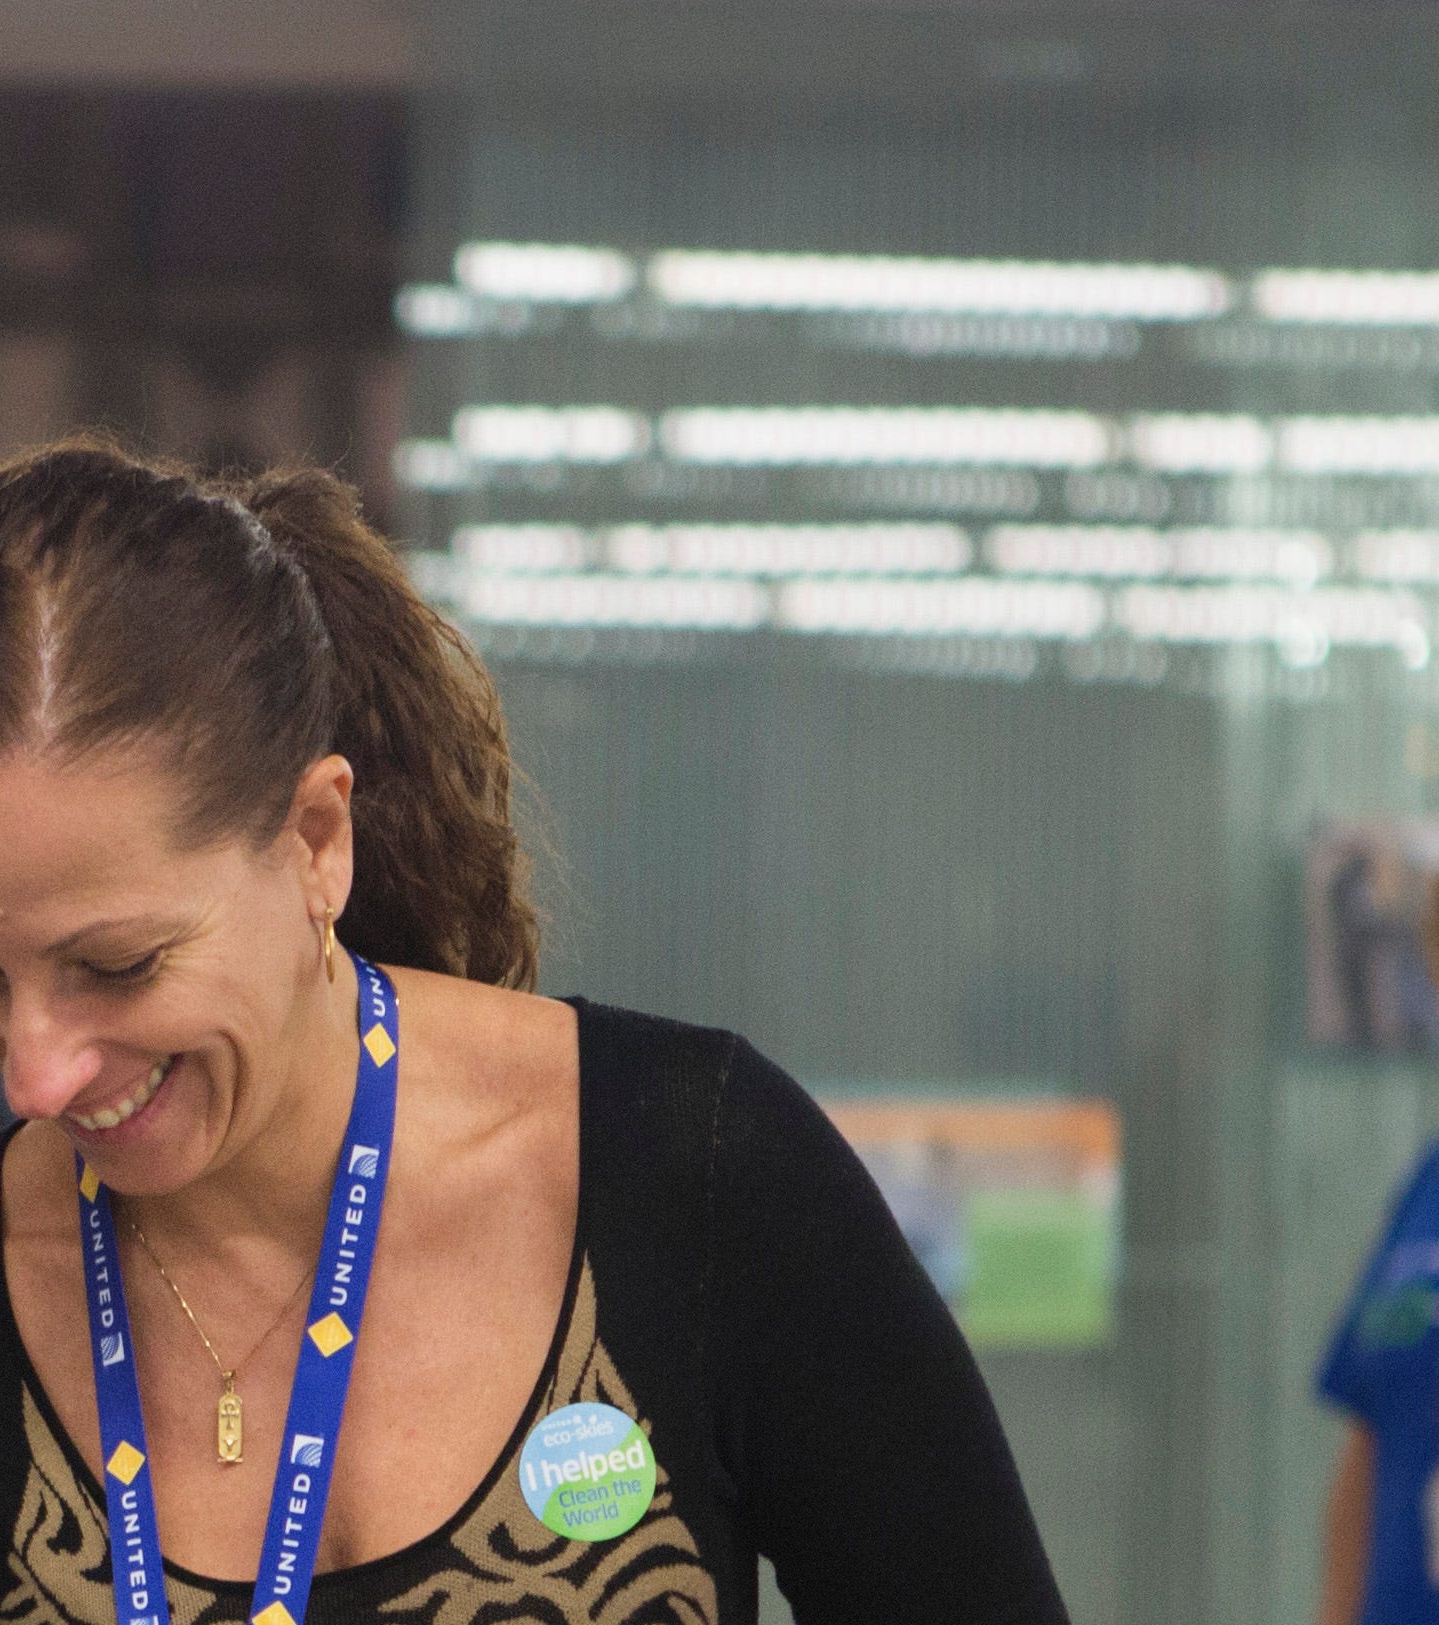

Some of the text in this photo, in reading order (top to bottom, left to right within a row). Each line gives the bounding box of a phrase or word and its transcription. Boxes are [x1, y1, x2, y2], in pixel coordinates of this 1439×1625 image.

[89, 1209, 114, 1328] UNITED
[329, 1183, 367, 1306] UNITED
[525, 1440, 645, 1492] I helped
[558, 1479, 642, 1509] Clean the
[562, 1501, 620, 1528] World
[121, 1490, 149, 1611] UNITED
[273, 1473, 311, 1595] UNITED
